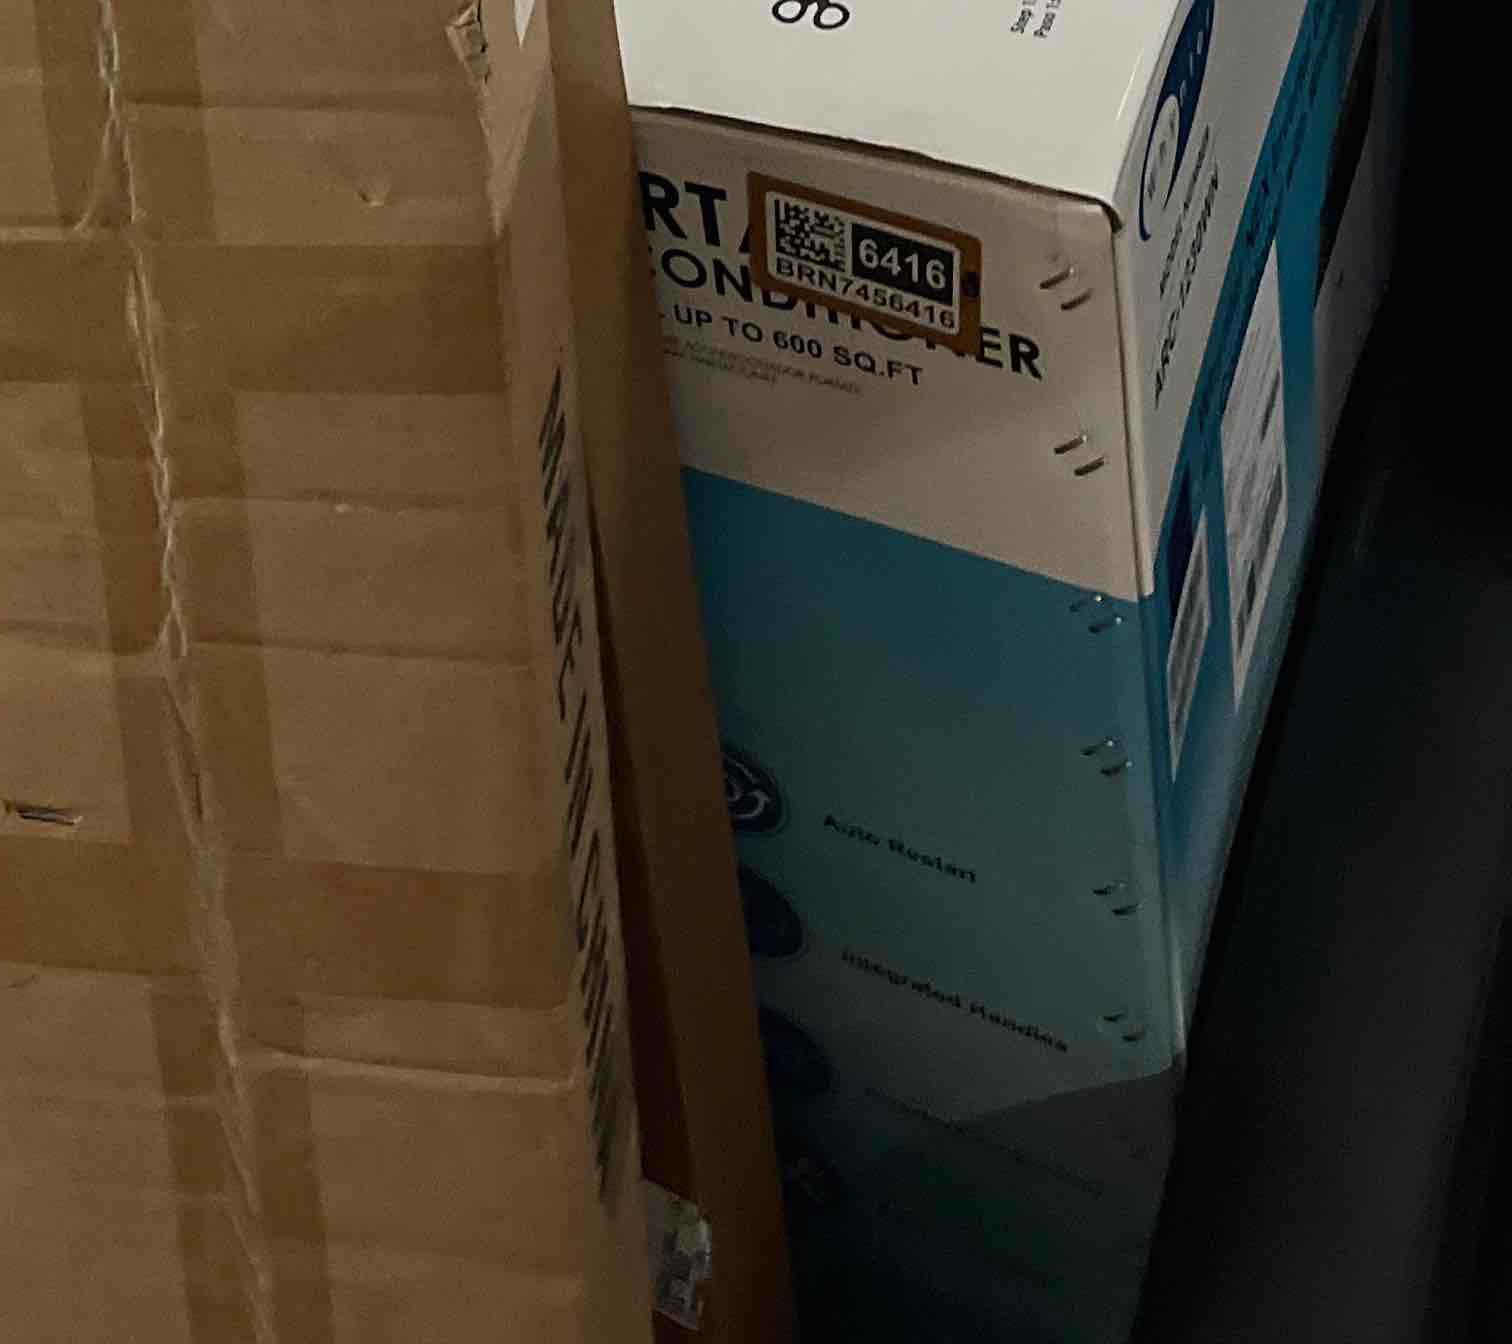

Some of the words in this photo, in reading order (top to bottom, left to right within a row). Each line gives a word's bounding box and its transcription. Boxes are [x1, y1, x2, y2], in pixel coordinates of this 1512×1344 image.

[775, 255, 957, 330] BRN7456416
[857, 238, 947, 291] 6416
[673, 303, 713, 329] UP
[721, 314, 764, 344] TO
[772, 330, 824, 360] 600
[832, 344, 925, 387] SQ.FT
